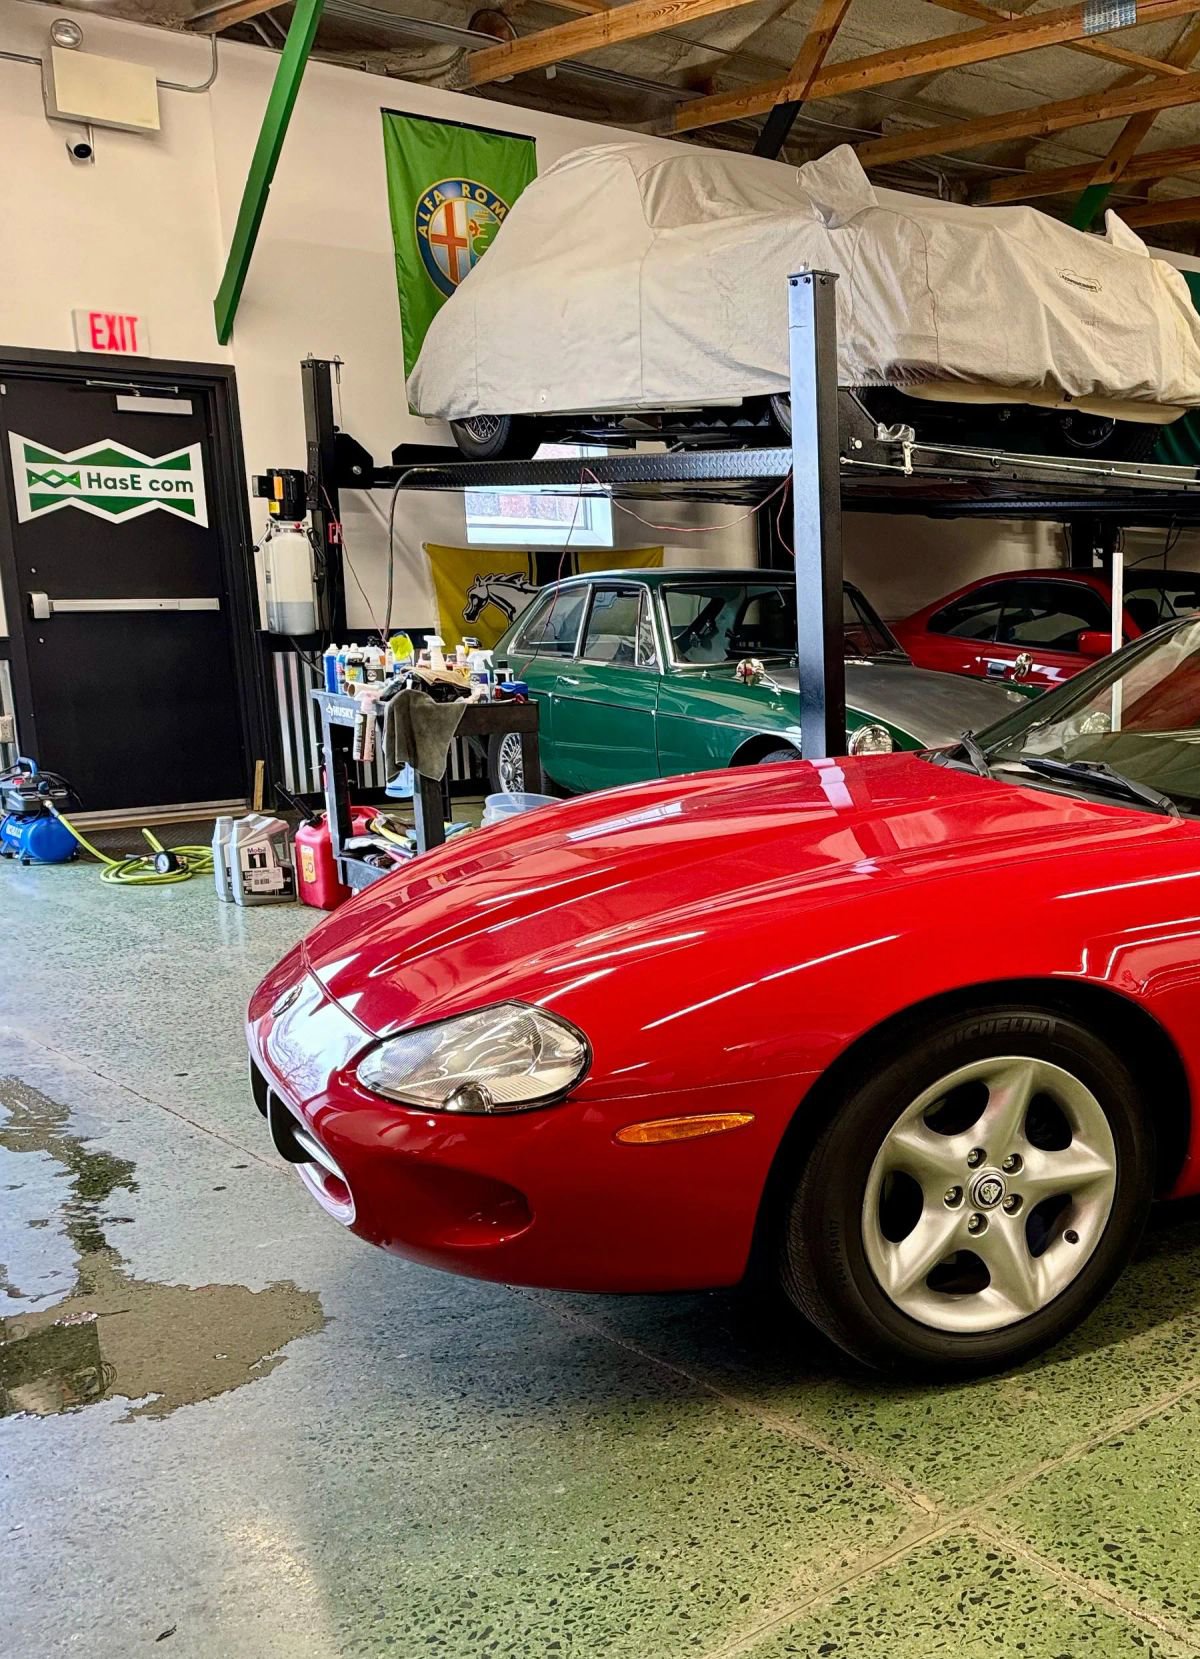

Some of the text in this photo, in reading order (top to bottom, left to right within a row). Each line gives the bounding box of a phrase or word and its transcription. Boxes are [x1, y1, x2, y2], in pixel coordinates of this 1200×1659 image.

[417, 183, 510, 239] ALFA ROM
[89, 312, 138, 352] EXIT
[87, 472, 194, 493] HasE com
[936, 1017, 1049, 1050] MICHELIN
